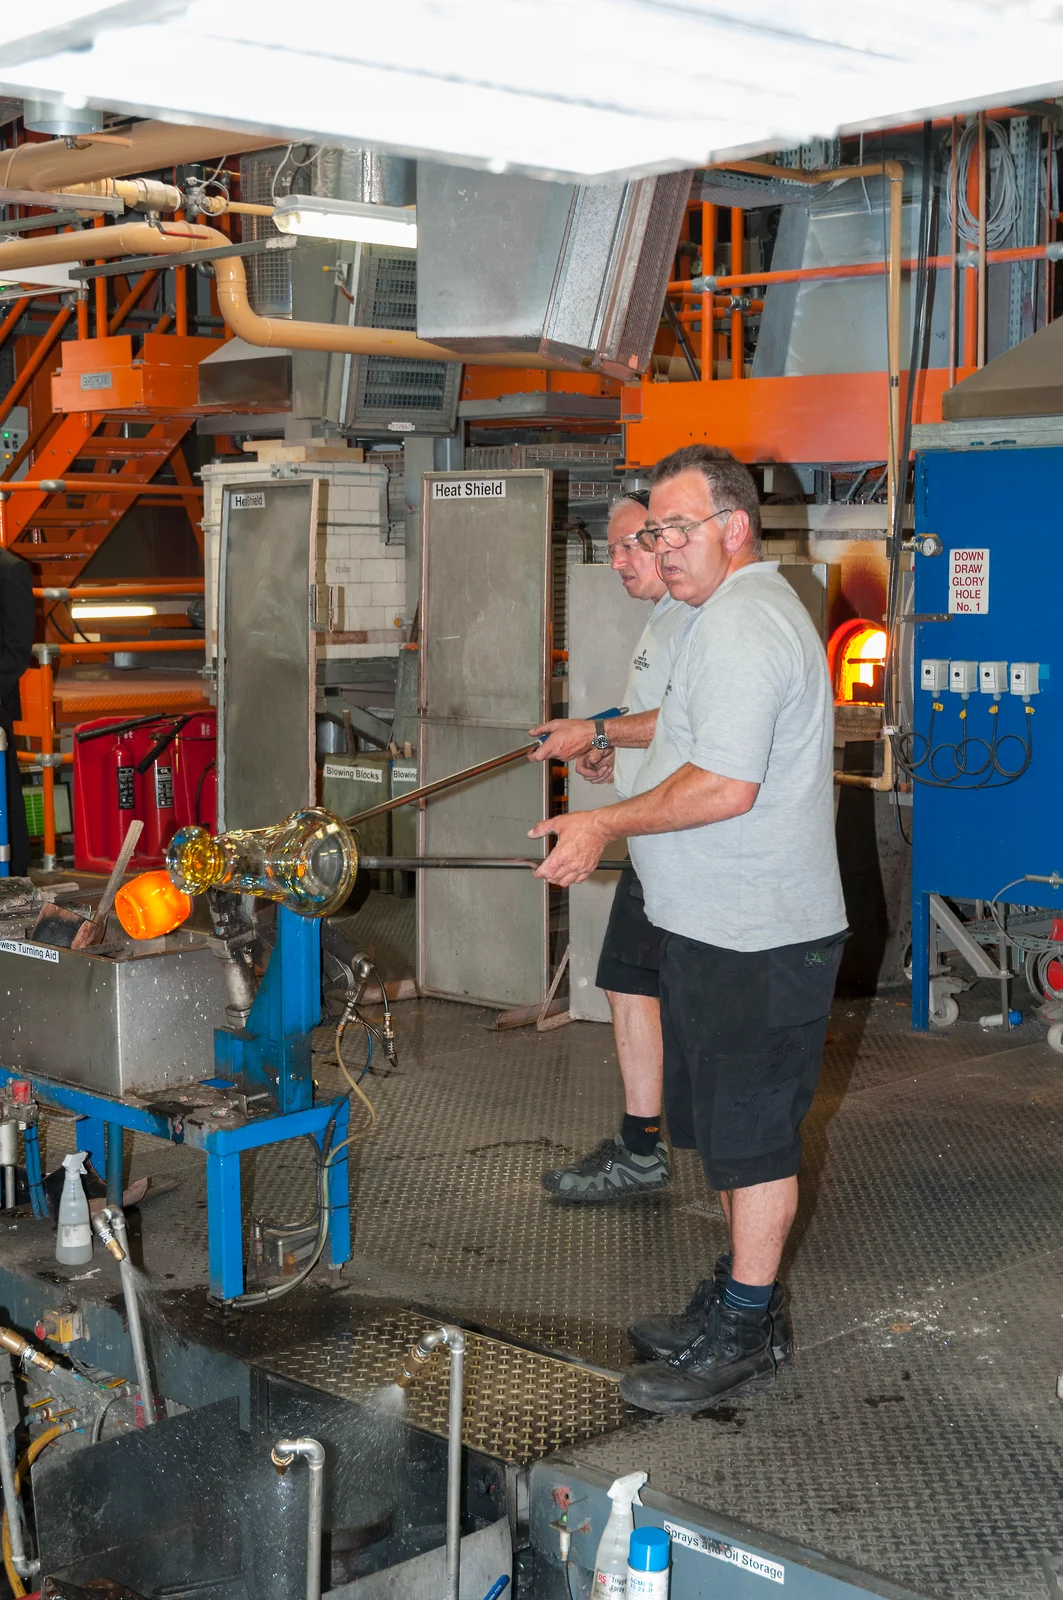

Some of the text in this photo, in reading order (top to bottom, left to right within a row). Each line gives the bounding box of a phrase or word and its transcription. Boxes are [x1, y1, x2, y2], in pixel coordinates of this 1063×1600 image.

[436, 482, 502, 497] Heat Shield
[954, 552, 984, 561] DOWN
[954, 564, 983, 573] DRAW
[952, 577, 985, 586] GLORY
[955, 590, 981, 599] HOLE
[956, 602, 980, 611] No. 1
[326, 767, 380, 780] Blowing Blocks
[0, 941, 57, 960] wers Turning Aid
[664, 1524, 699, 1546] Sprays
[724, 1549, 739, 1561] Oil
[742, 1555, 783, 1578] Storage
